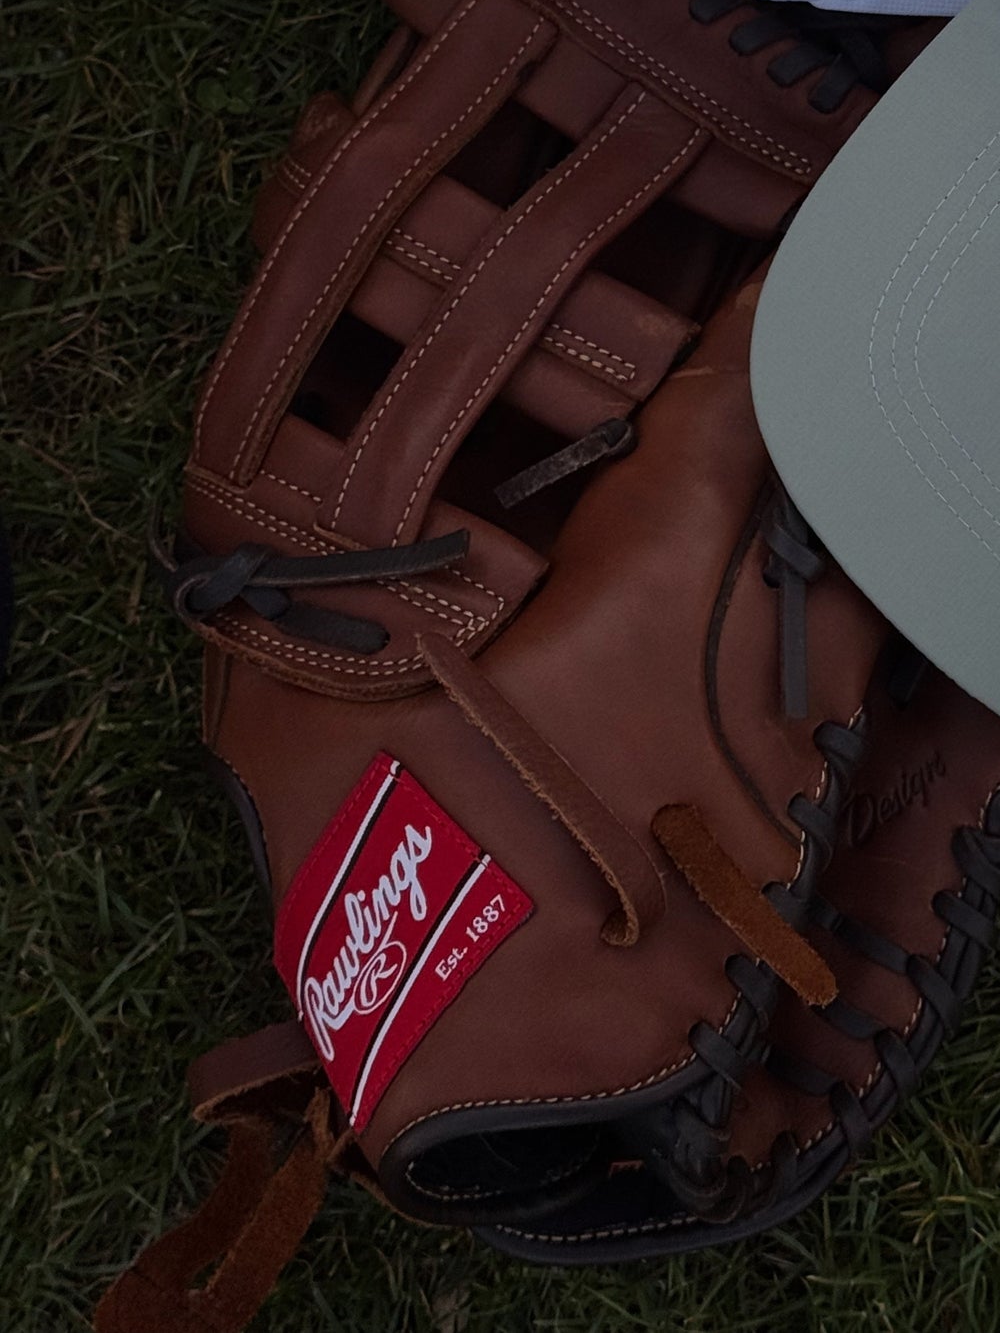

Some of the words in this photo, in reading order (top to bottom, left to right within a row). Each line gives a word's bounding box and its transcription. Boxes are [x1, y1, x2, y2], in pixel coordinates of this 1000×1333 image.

[847, 750, 947, 849] Design
[303, 823, 432, 1062] Rawlings
[434, 943, 470, 982] Est.
[466, 894, 508, 943] 1887
